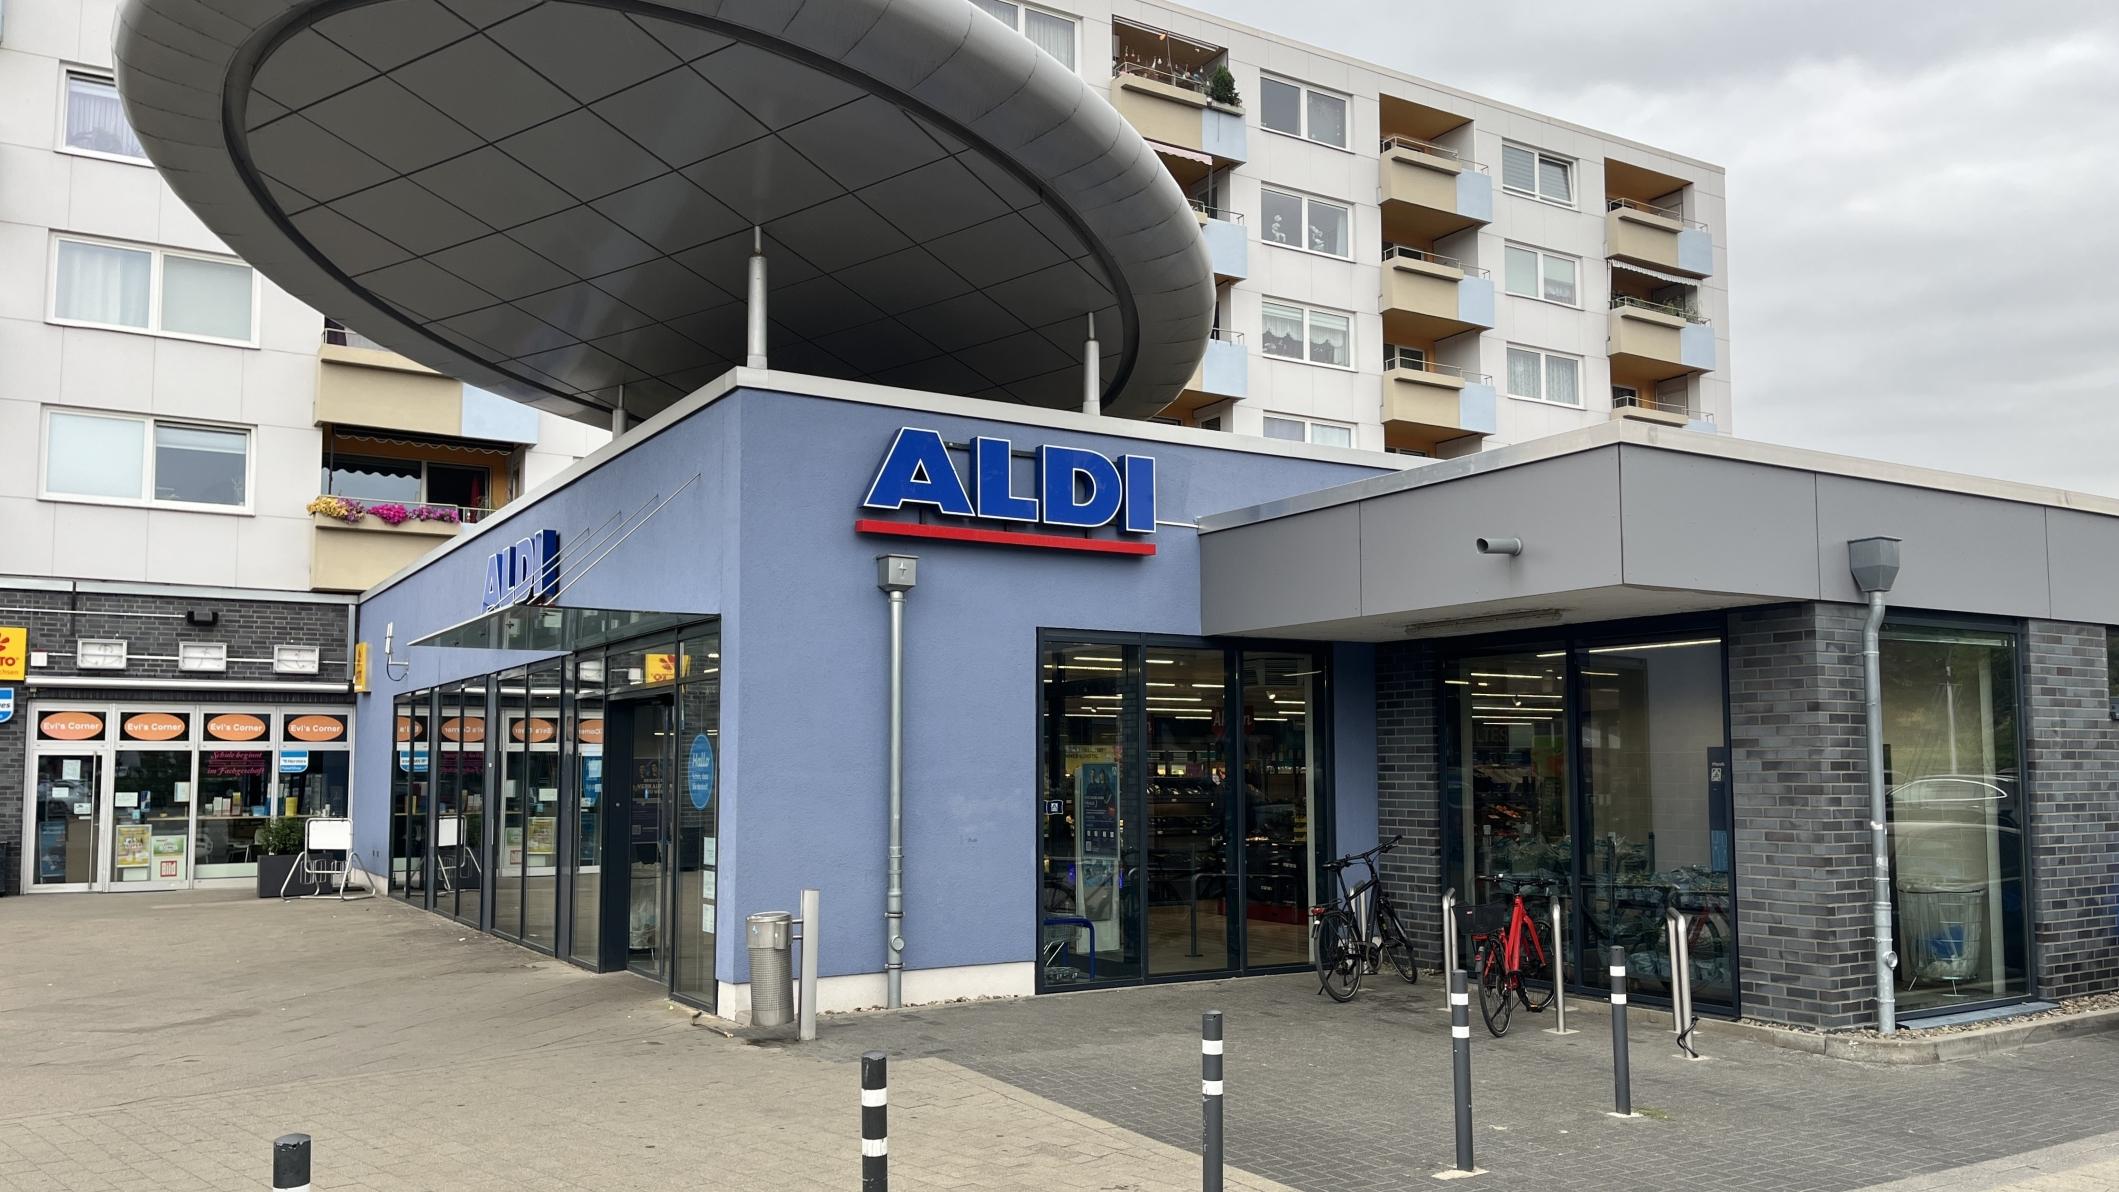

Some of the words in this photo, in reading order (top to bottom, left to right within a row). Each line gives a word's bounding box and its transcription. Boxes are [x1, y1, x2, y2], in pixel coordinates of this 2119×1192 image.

[864, 426, 1156, 533] ALDI
[481, 529, 557, 613] ALDI
[43, 722, 65, 730] Evi's
[68, 722, 99, 730] Corner
[151, 723, 182, 731] Corner
[210, 723, 230, 731] Evi's
[233, 724, 263, 732] Corner
[291, 724, 310, 732] Evi's
[209, 751, 235, 760] Schule
[236, 752, 263, 761] beginnt
[692, 752, 710, 768] Hallo
